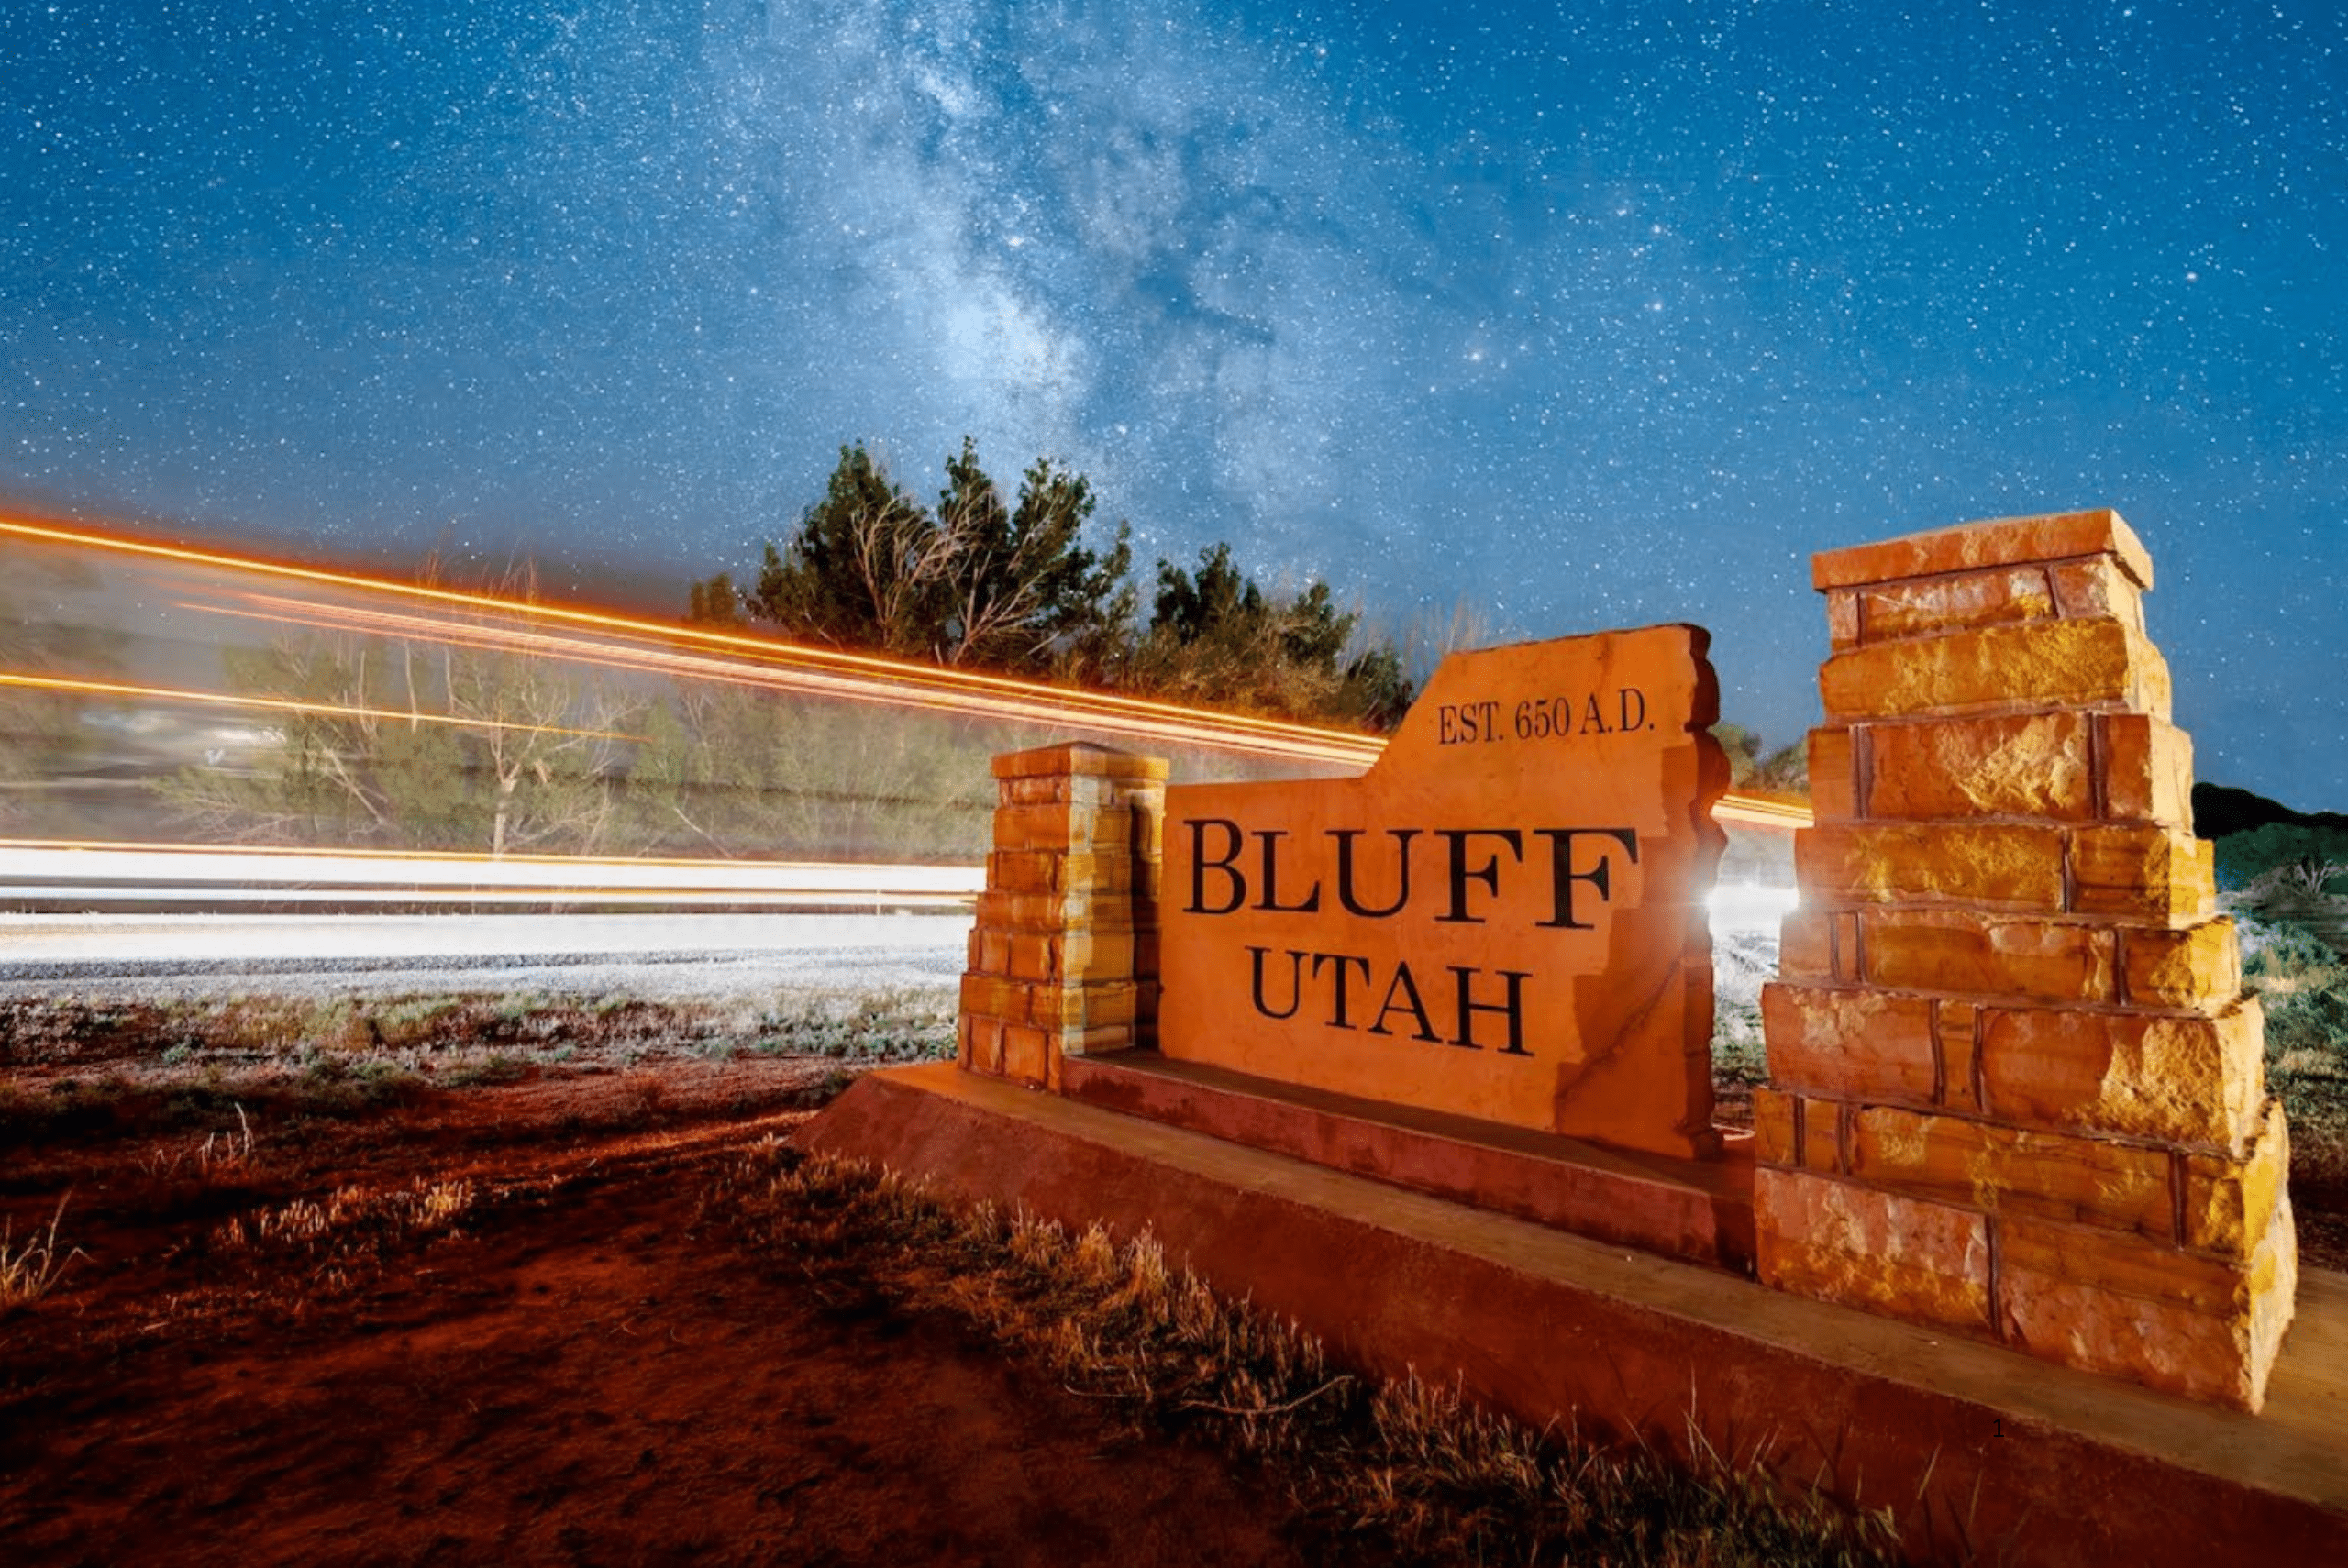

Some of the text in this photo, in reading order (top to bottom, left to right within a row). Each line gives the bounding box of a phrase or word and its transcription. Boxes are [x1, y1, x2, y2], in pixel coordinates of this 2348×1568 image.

[1438, 688, 1655, 745] EST. 650 A.D.
[1182, 819, 1638, 929] BLUFF
[1244, 945, 1534, 1056] UTAH
